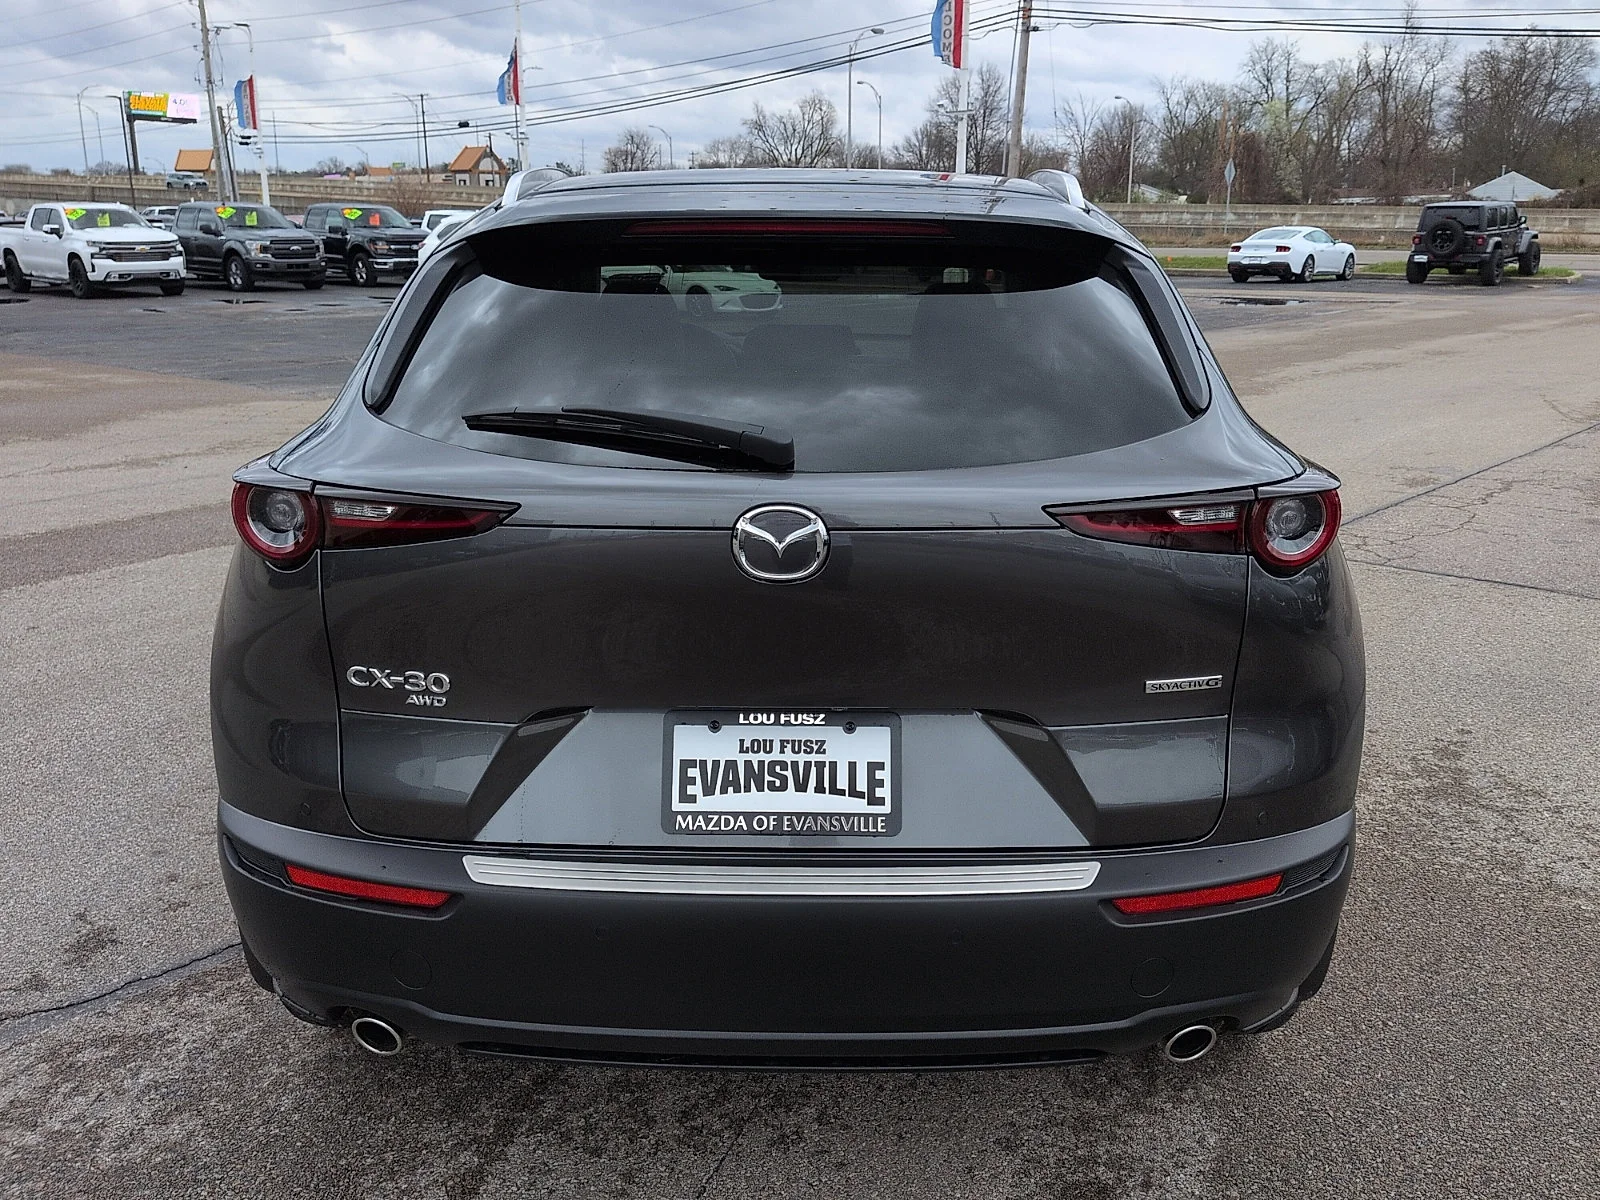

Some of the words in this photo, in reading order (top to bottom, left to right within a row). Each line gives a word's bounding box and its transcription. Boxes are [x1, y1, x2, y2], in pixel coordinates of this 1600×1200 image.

[346, 665, 451, 694] CX-30
[405, 694, 447, 707] AWD
[738, 713, 775, 725] LOU
[780, 713, 826, 725] FUSZ
[738, 738, 774, 754] LOU
[779, 739, 827, 755] FUSZ
[678, 758, 886, 807] EVANSVILLE
[675, 814, 747, 831] MAZDA
[753, 815, 777, 831] OF
[782, 815, 886, 833] EVANSVILLE
